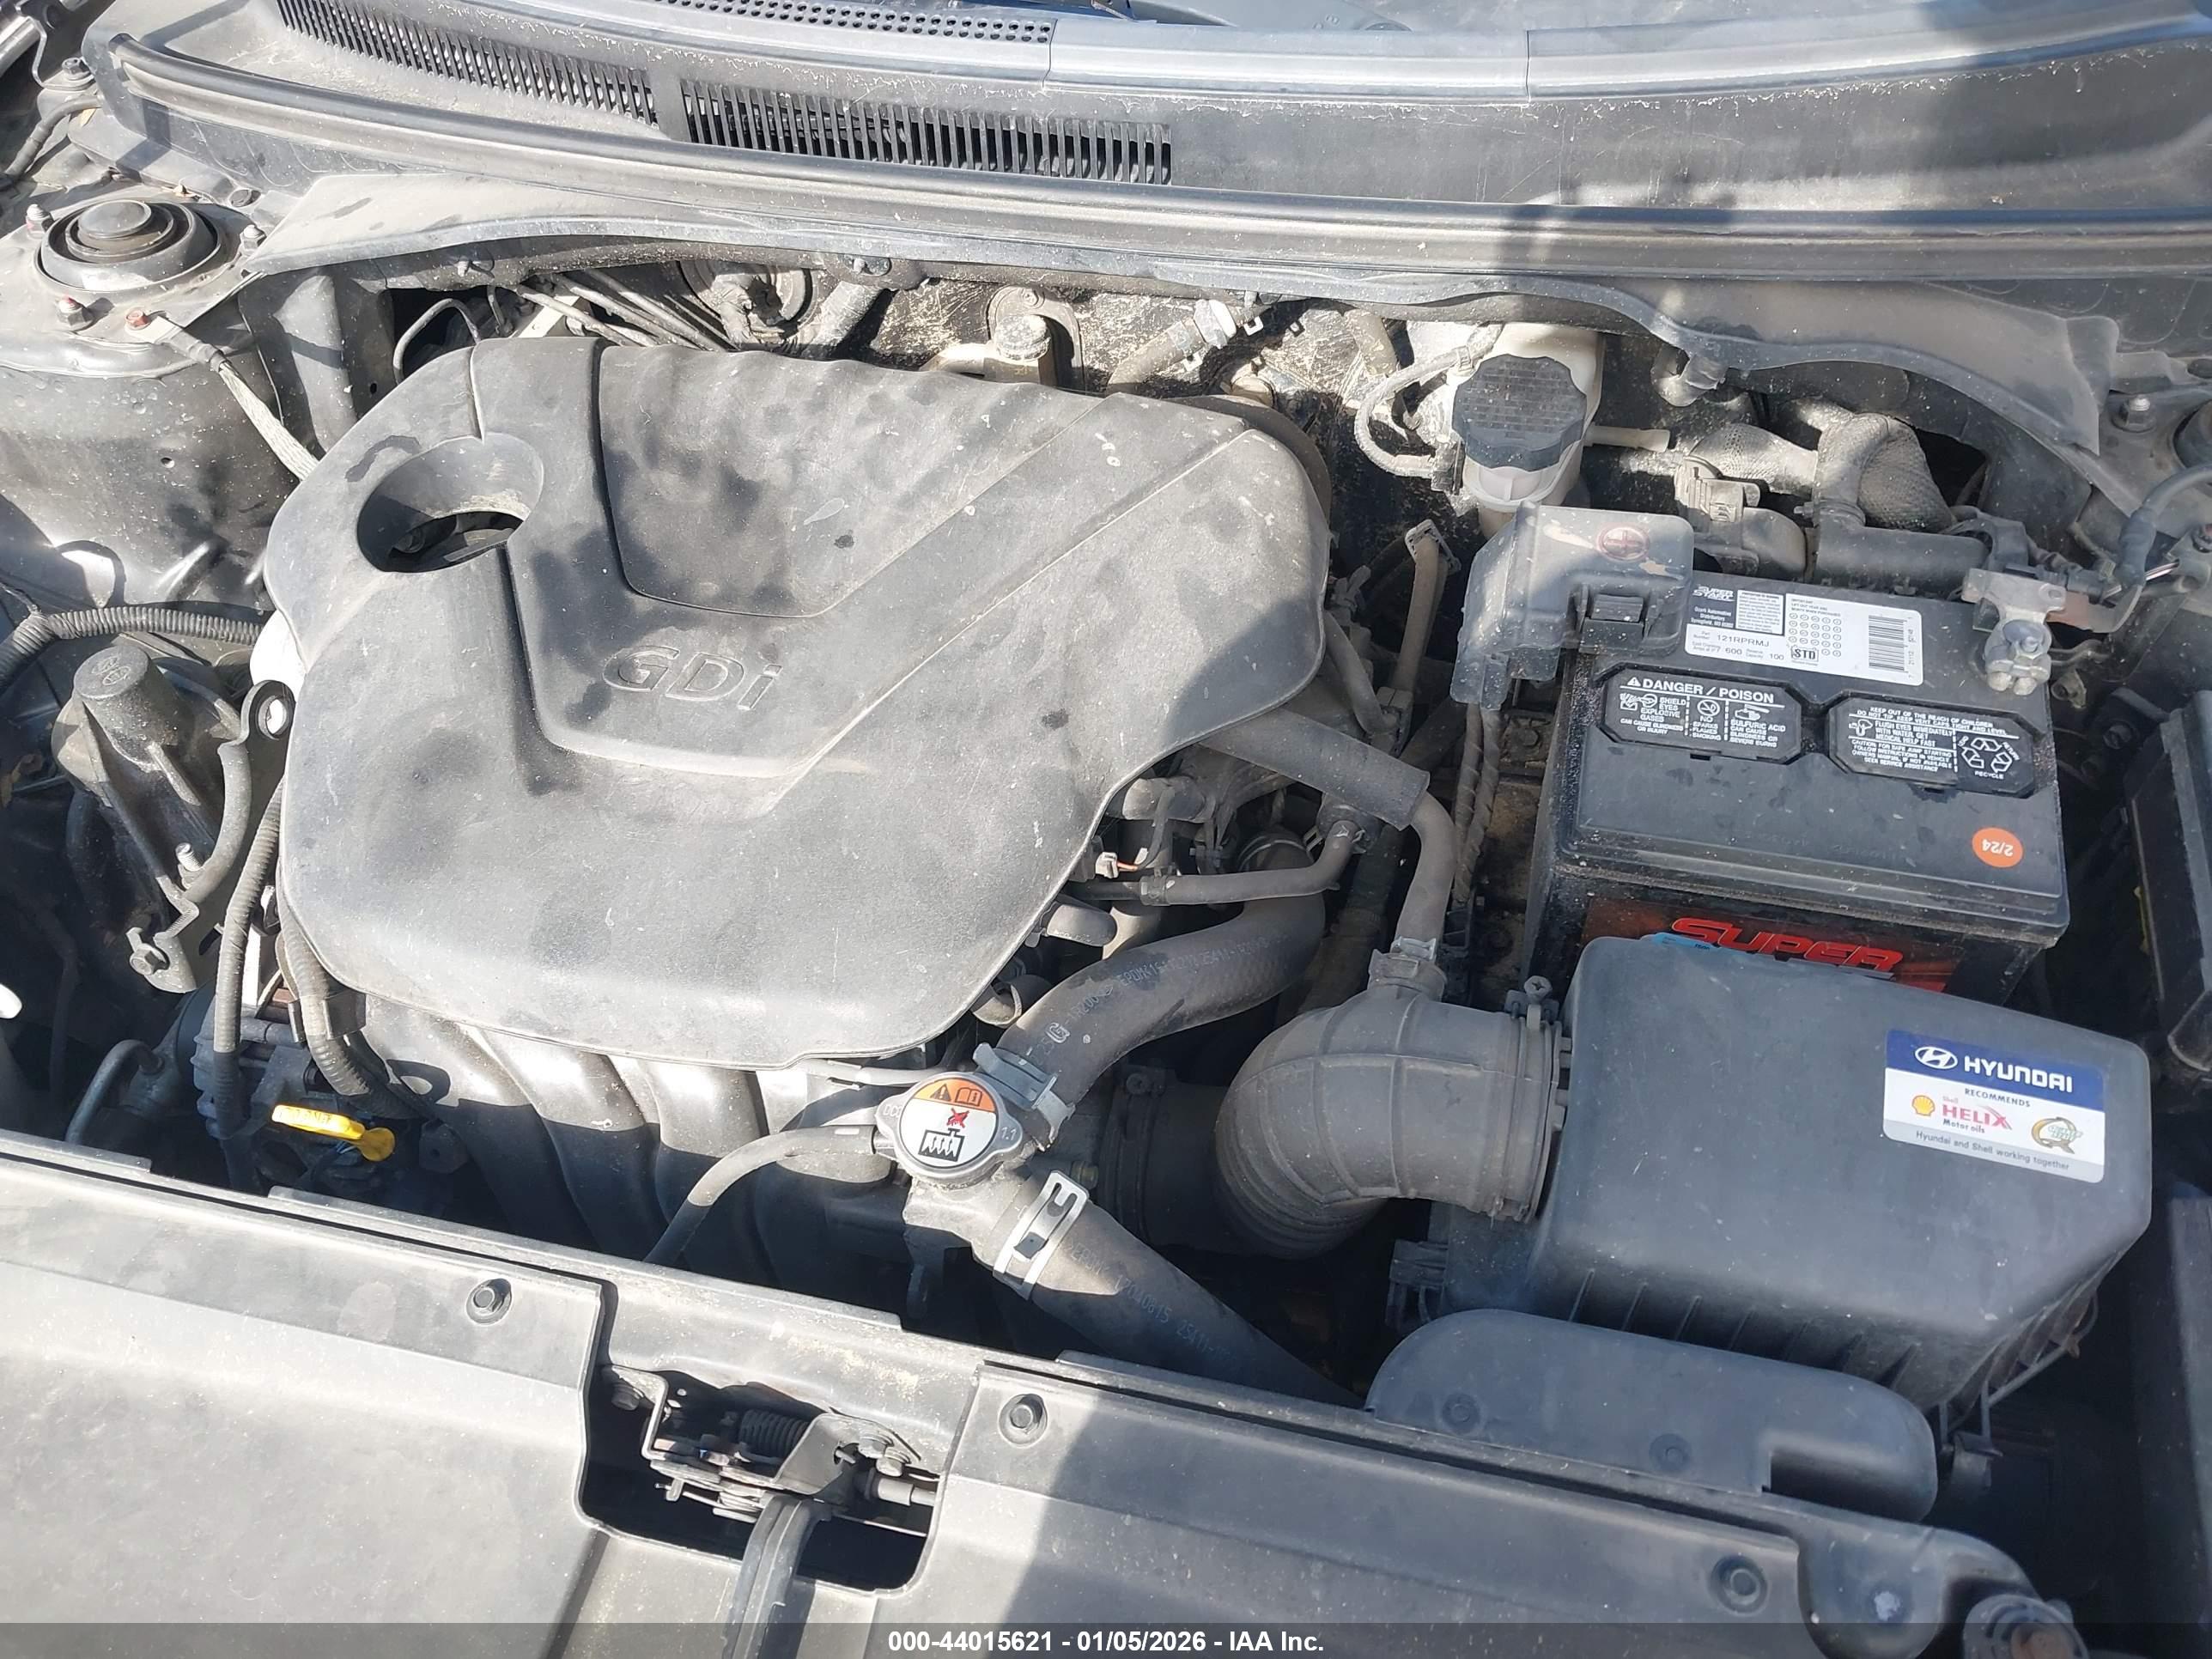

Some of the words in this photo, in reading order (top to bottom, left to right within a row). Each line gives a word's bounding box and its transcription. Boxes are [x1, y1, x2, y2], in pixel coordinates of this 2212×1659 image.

[602, 645, 783, 711] GDi
[1643, 678, 1704, 695] DANGER
[1719, 687, 1774, 703] POISON
[1659, 696, 1686, 706] SHIELD
[1640, 707, 1680, 718] EXPLOSIVE
[1640, 714, 1664, 722] GASES
[1928, 714, 1949, 723] REACH
[1692, 726, 1717, 735] FLAMES
[1730, 719, 1767, 730] SULFURIC
[1768, 724, 1786, 732] ACID
[1746, 726, 1767, 736] CAUSE
[1875, 720, 1894, 729] FLUSH
[1903, 737, 1919, 745] HELP
[1920, 739, 1936, 748] FAST
[2002, 741, 2020, 761] RETURN
[1974, 770, 2004, 780] RECYCLE
[1981, 837, 2014, 857] 2/24
[1671, 917, 1904, 973] SUPER
[1964, 1055, 2073, 1093] HYUNDAI
[1965, 1087, 2031, 1108] RECOMMENDS
[1942, 1104, 2013, 1131] HELIX
[1942, 1118, 1969, 1130] Motor
[1971, 1123, 1985, 1133] oils
[1916, 1129, 1951, 1145] Hyundai
[1954, 1137, 1970, 1148] and
[1972, 1142, 1993, 1155] Shell
[1996, 1147, 2031, 1164] working
[2033, 1156, 2069, 1171] together
